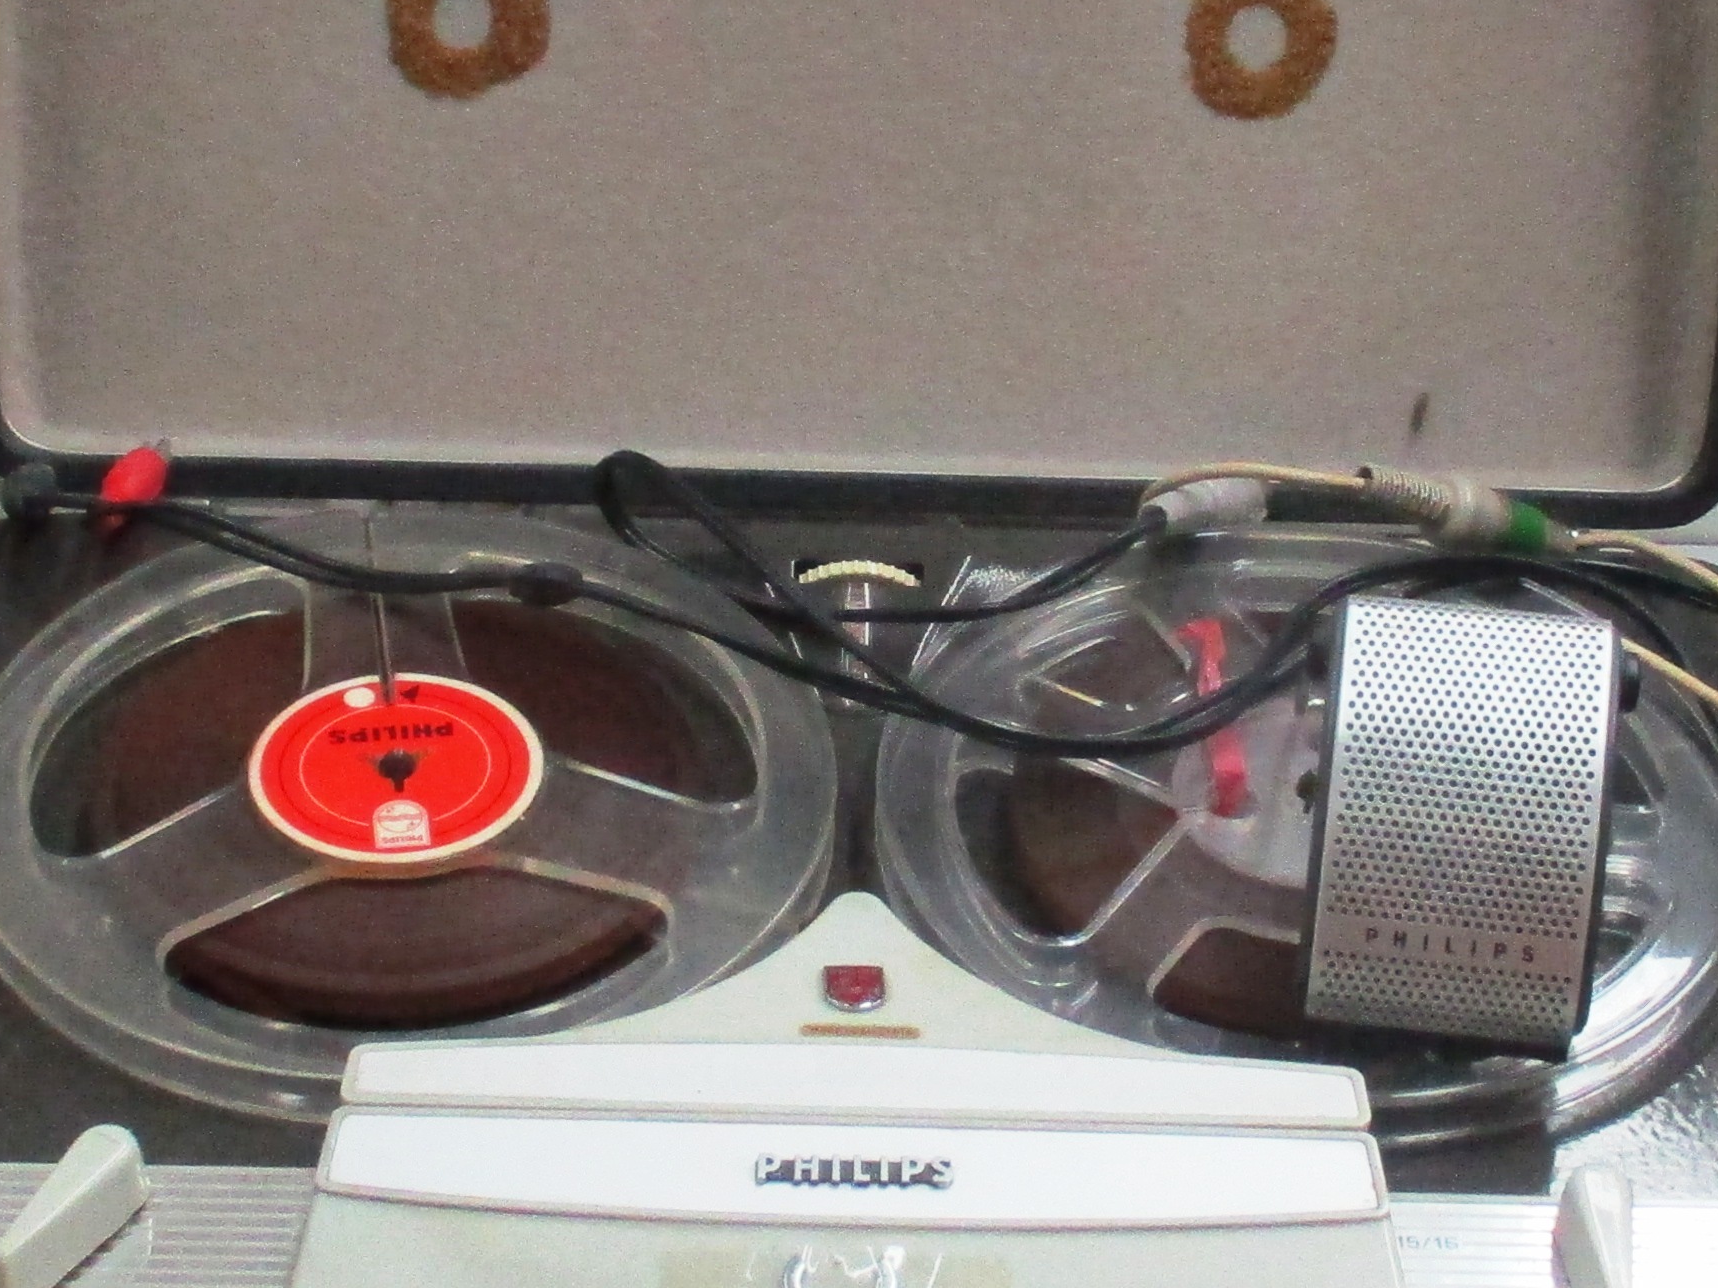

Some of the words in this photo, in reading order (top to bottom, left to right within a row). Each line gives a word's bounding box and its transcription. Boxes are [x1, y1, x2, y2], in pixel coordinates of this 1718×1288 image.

[327, 722, 455, 746] PHILIPS
[1364, 926, 1537, 964] PHILIPS
[755, 1153, 954, 1189] PHILIPS
